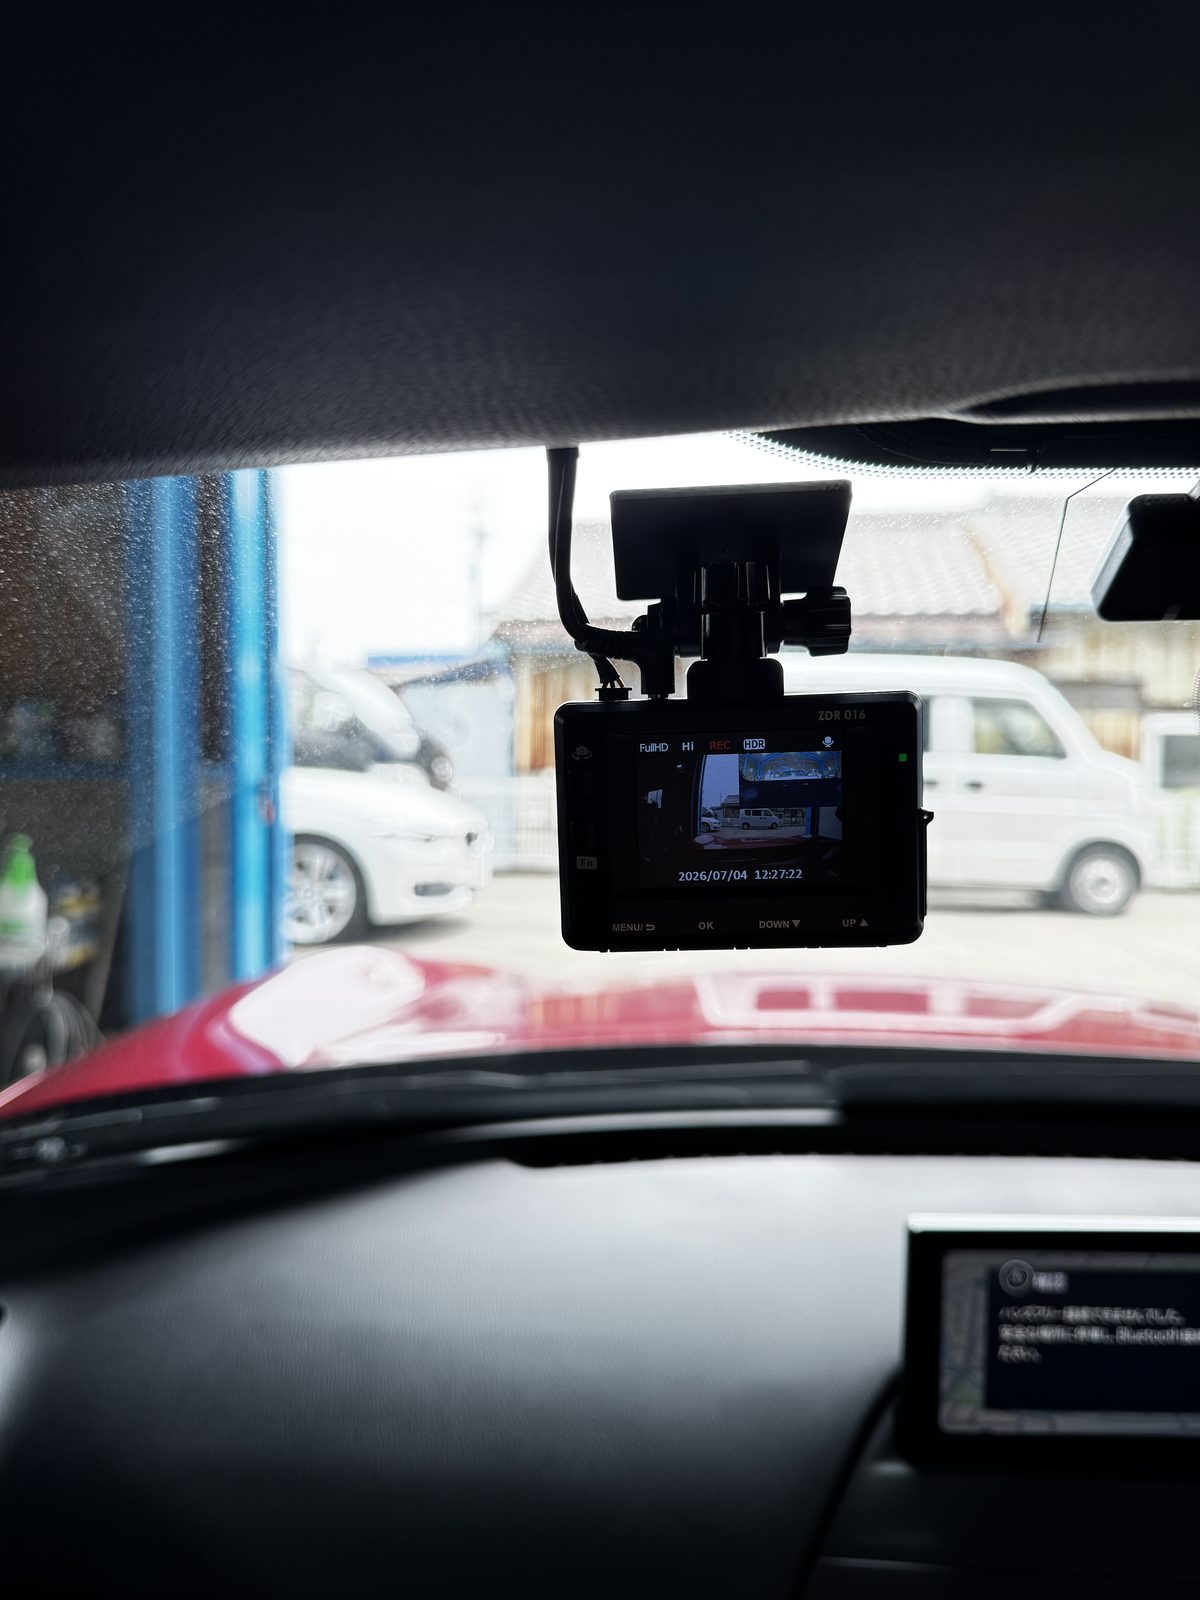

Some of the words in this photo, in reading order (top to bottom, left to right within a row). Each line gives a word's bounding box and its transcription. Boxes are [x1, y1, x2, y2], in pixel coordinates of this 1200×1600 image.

[818, 709, 842, 721] ZDR
[844, 709, 867, 720] 016
[639, 741, 669, 753] FullHD
[682, 741, 694, 752] Hi
[709, 740, 731, 750] REC
[744, 739, 765, 750] HDR
[580, 858, 593, 868] Fn
[678, 869, 748, 882] 2026/07/04
[754, 868, 803, 880] 12:27:22
[698, 920, 714, 930] OK
[758, 919, 791, 929] DOWN
[842, 918, 857, 928] UP
